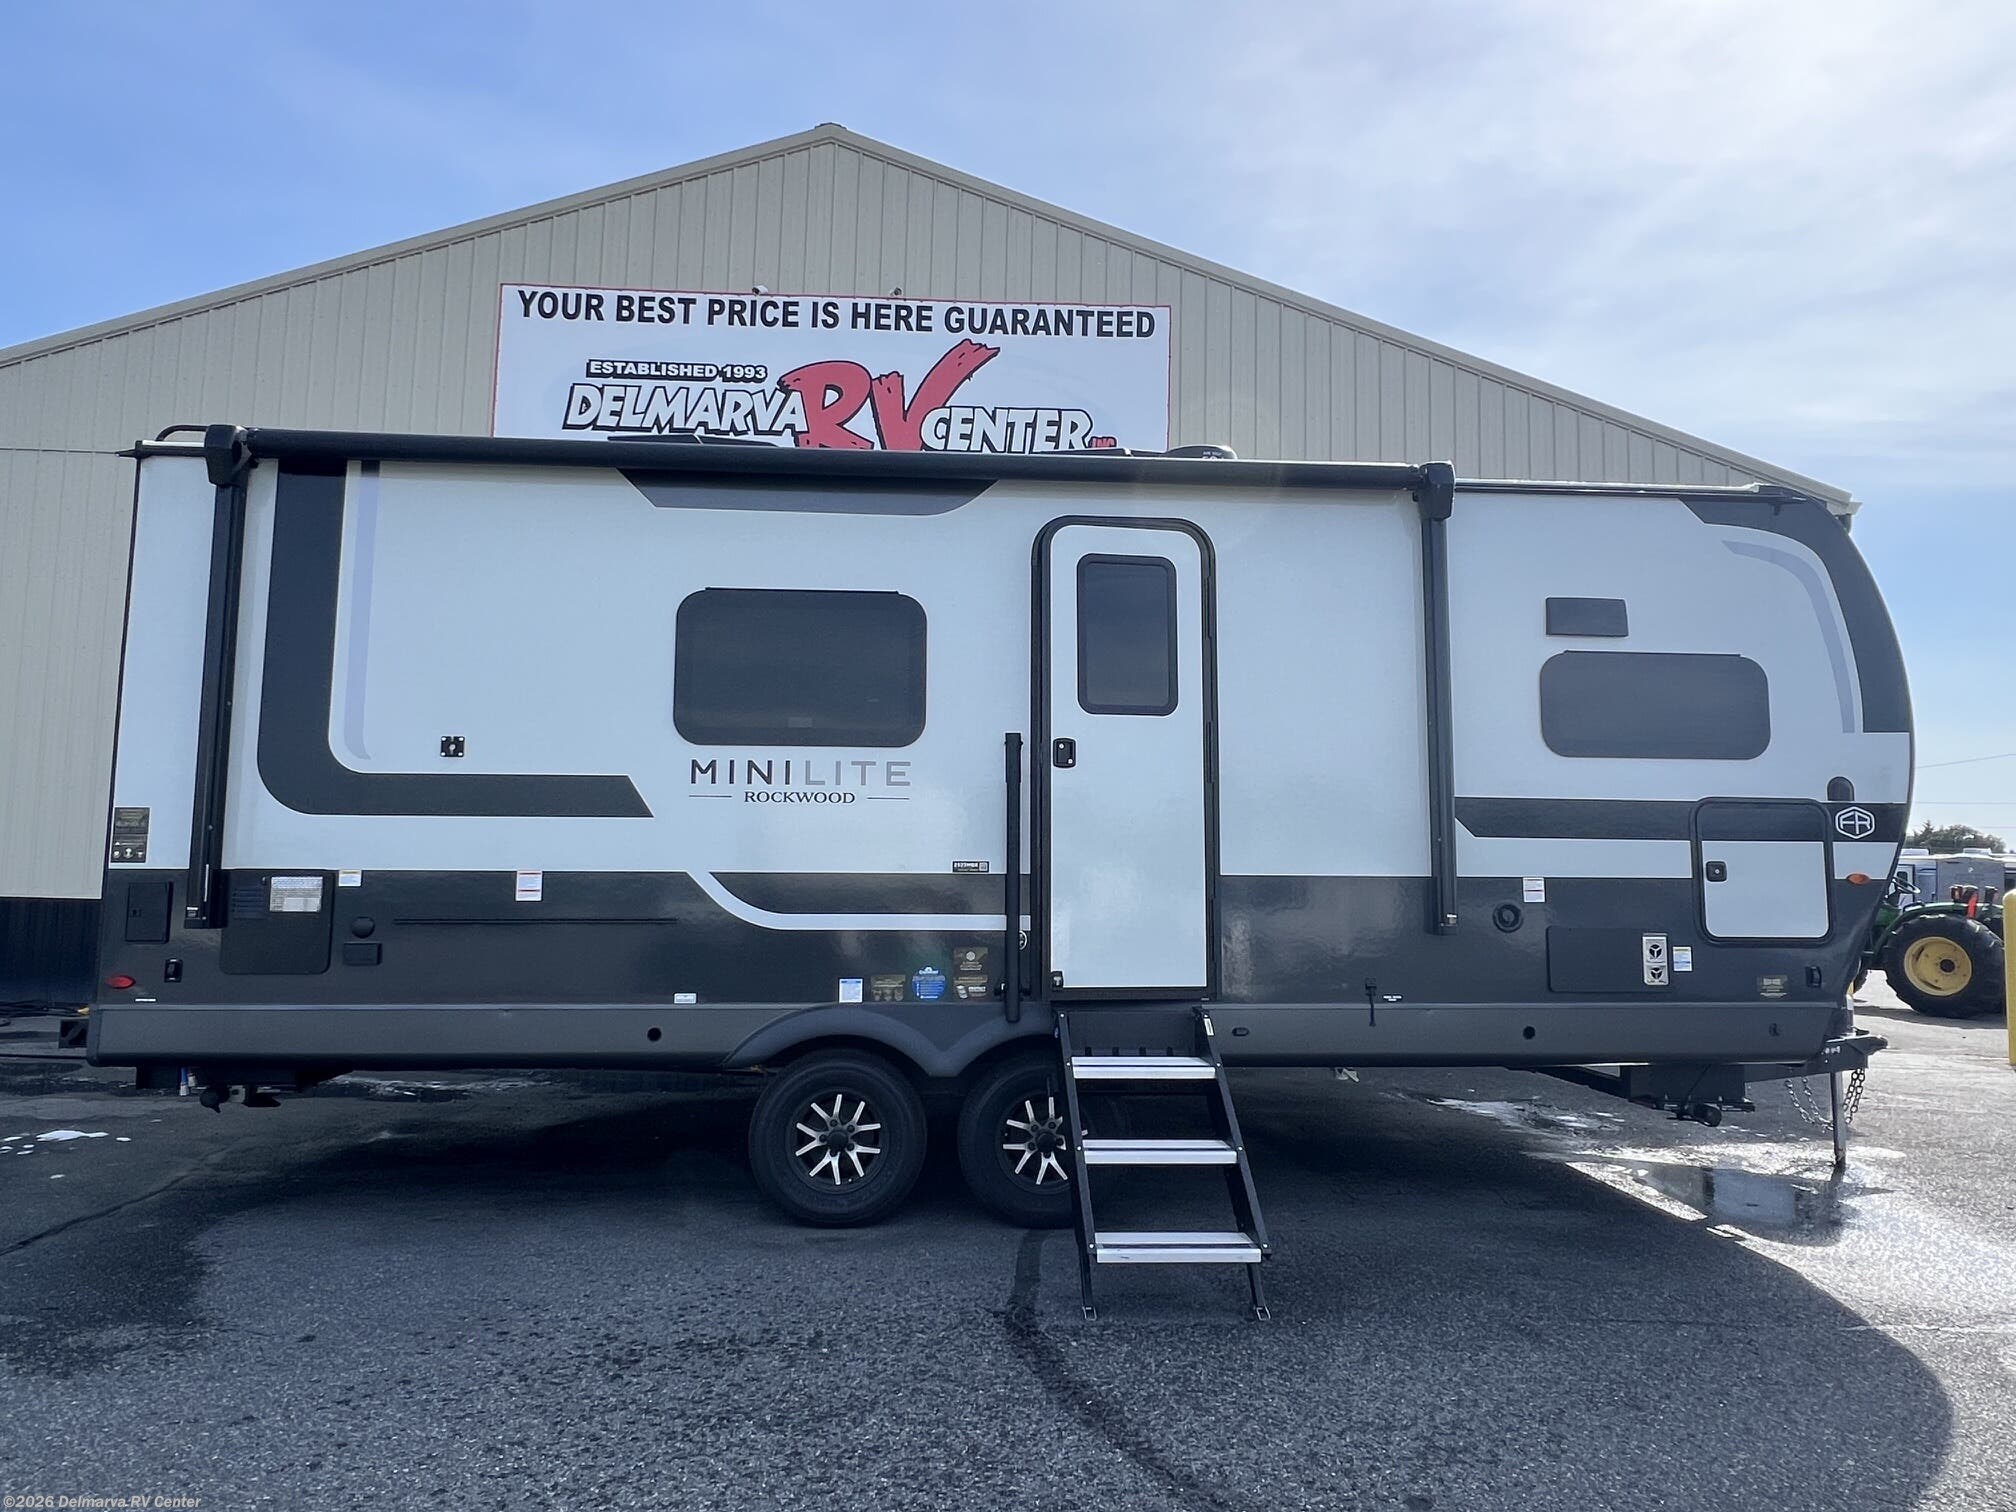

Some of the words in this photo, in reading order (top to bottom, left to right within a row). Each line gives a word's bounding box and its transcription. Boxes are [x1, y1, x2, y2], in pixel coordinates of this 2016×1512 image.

[518, 290, 604, 321] YOUR
[616, 295, 696, 324] BEST
[707, 299, 799, 328] PRICE
[811, 301, 839, 329] IS
[851, 302, 933, 332] HERE
[944, 306, 1155, 338] GUARANTEED
[588, 360, 718, 379] ESTABLISHED
[721, 365, 767, 380] 1993
[562, 383, 809, 435] DELMARVA
[777, 338, 1000, 450] RV
[920, 406, 1092, 453] CENTER
[691, 758, 911, 787] MINILITE
[744, 791, 855, 804] ROCKWOOD
